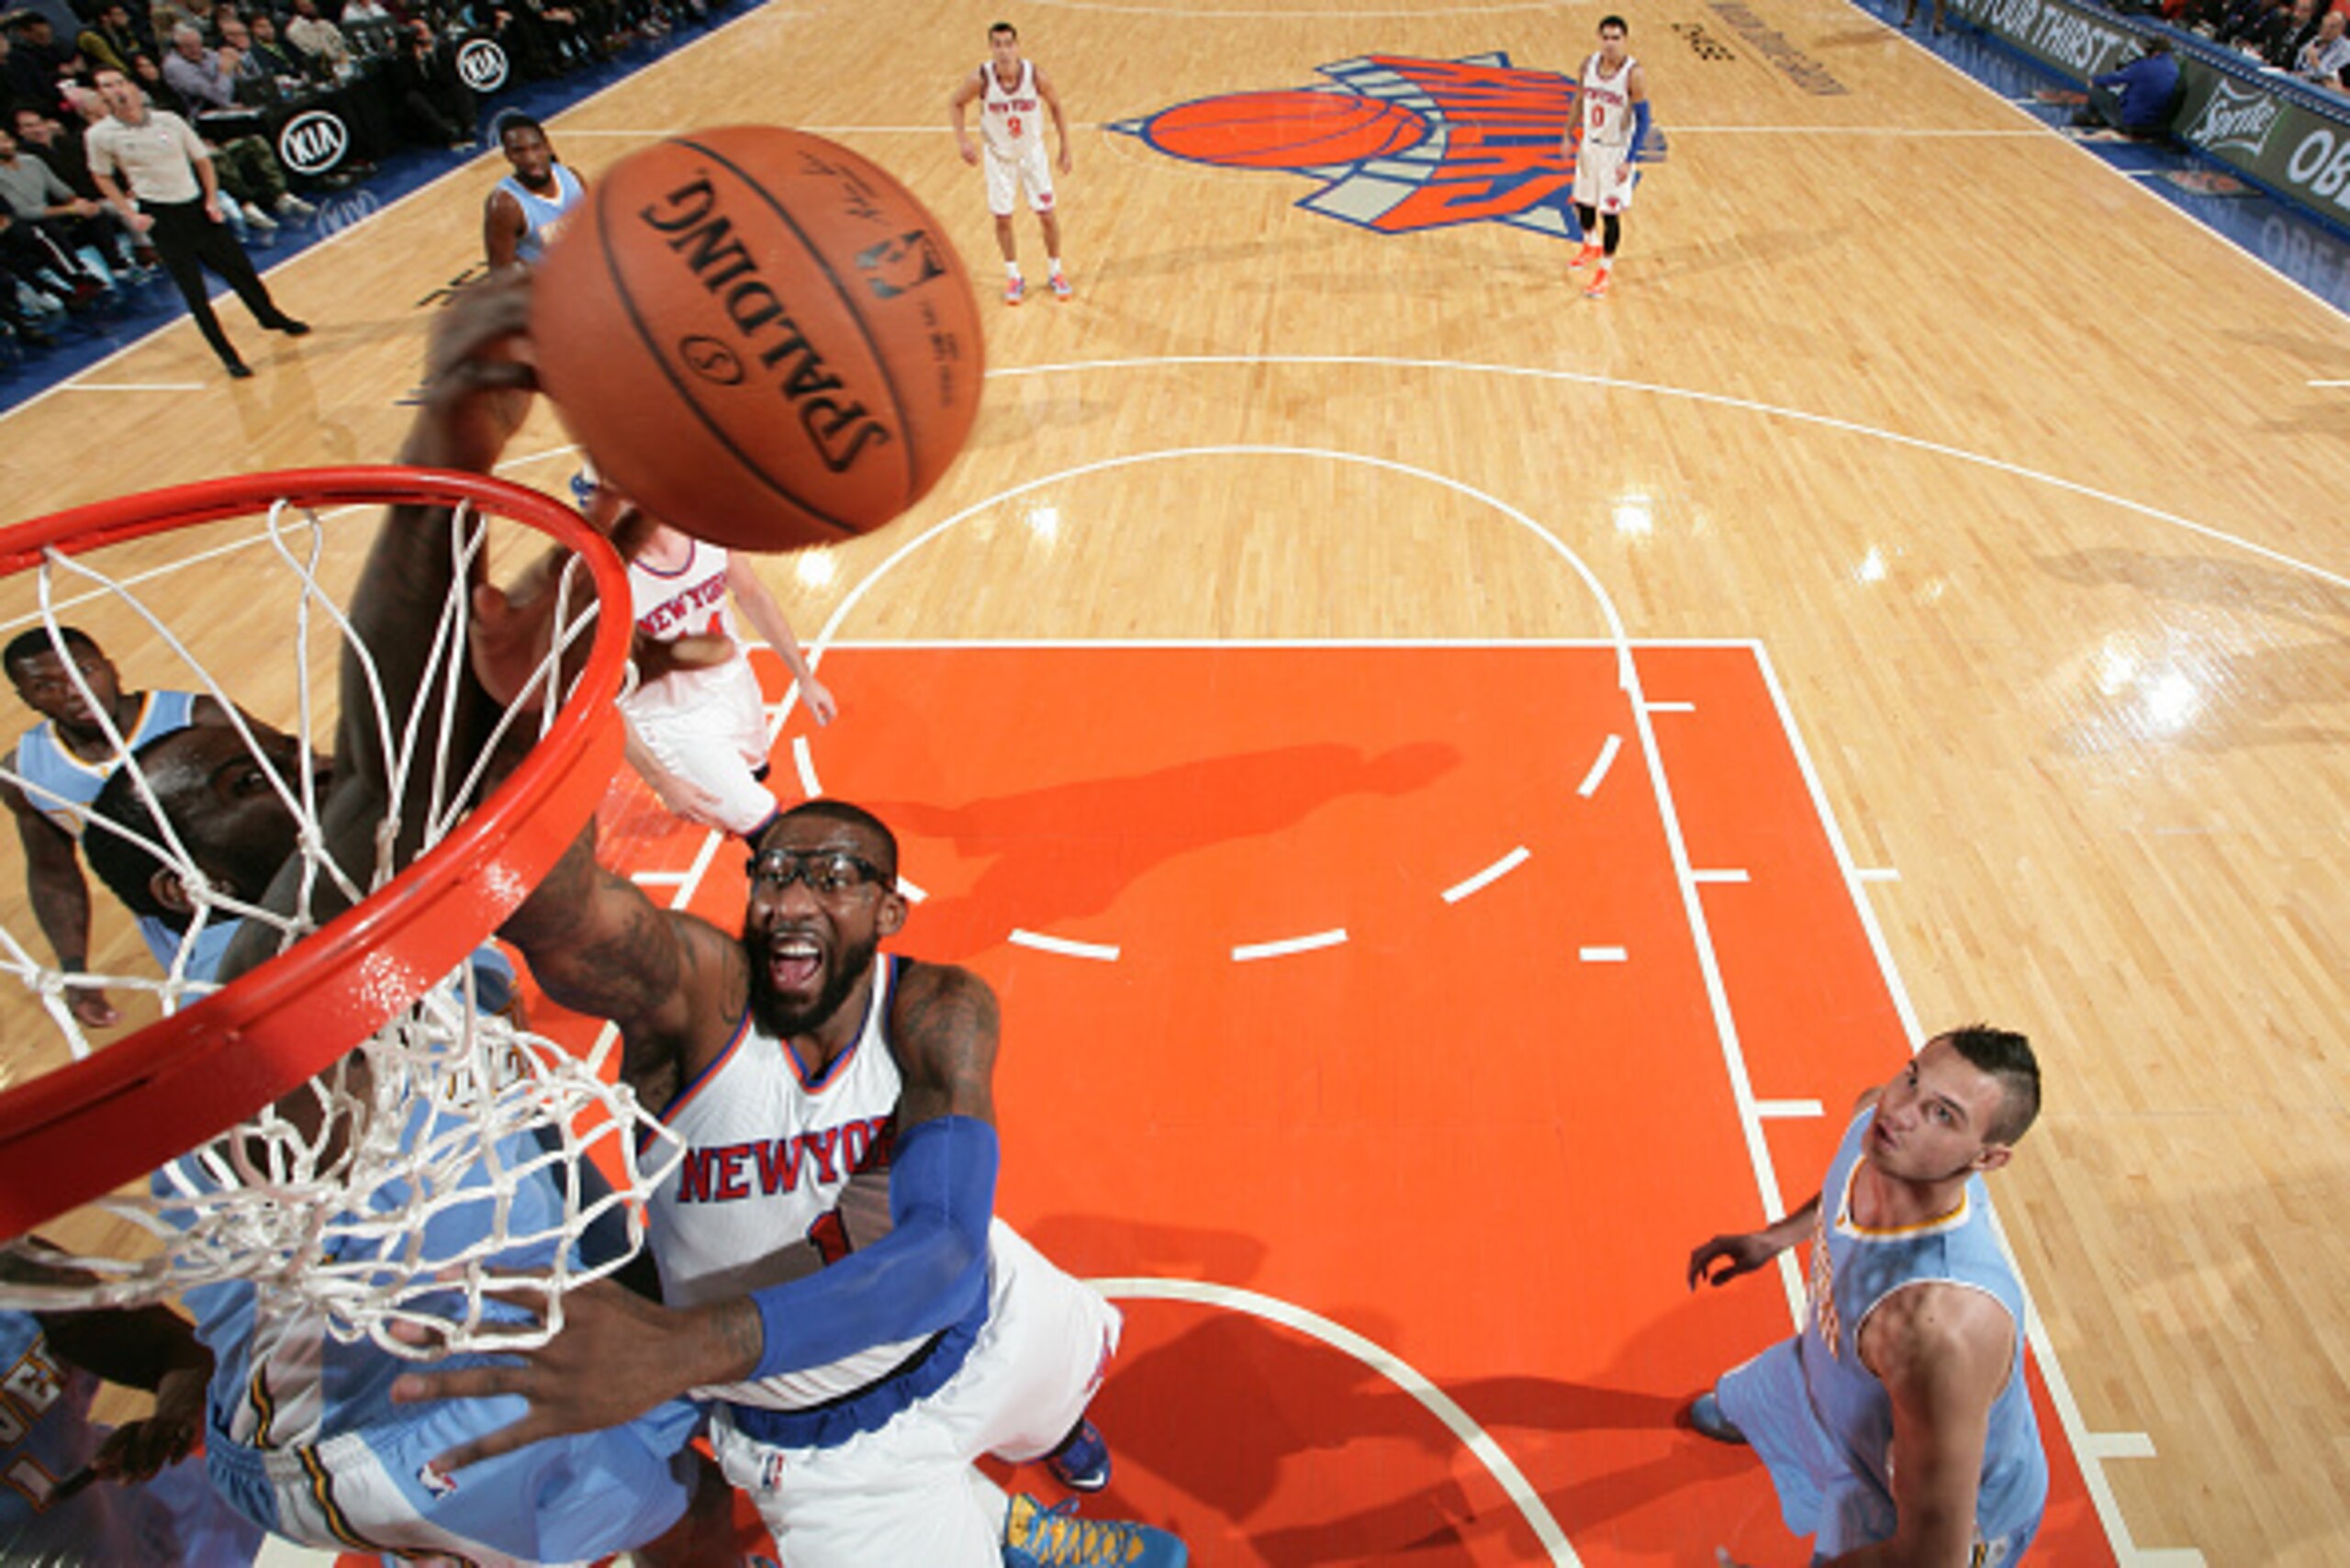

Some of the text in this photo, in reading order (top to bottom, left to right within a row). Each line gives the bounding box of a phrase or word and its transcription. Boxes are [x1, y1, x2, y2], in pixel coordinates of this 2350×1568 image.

[462, 46, 501, 83] KIA
[2032, 5, 2121, 75] THIRST
[285, 120, 341, 165] KIA
[1007, 116, 1022, 140] 9
[1591, 105, 1605, 128] 0
[2191, 94, 2277, 147] Sprite
[639, 178, 890, 473] SPALDING
[676, 1134, 804, 1203] NEW
[806, 1206, 853, 1266] 1
